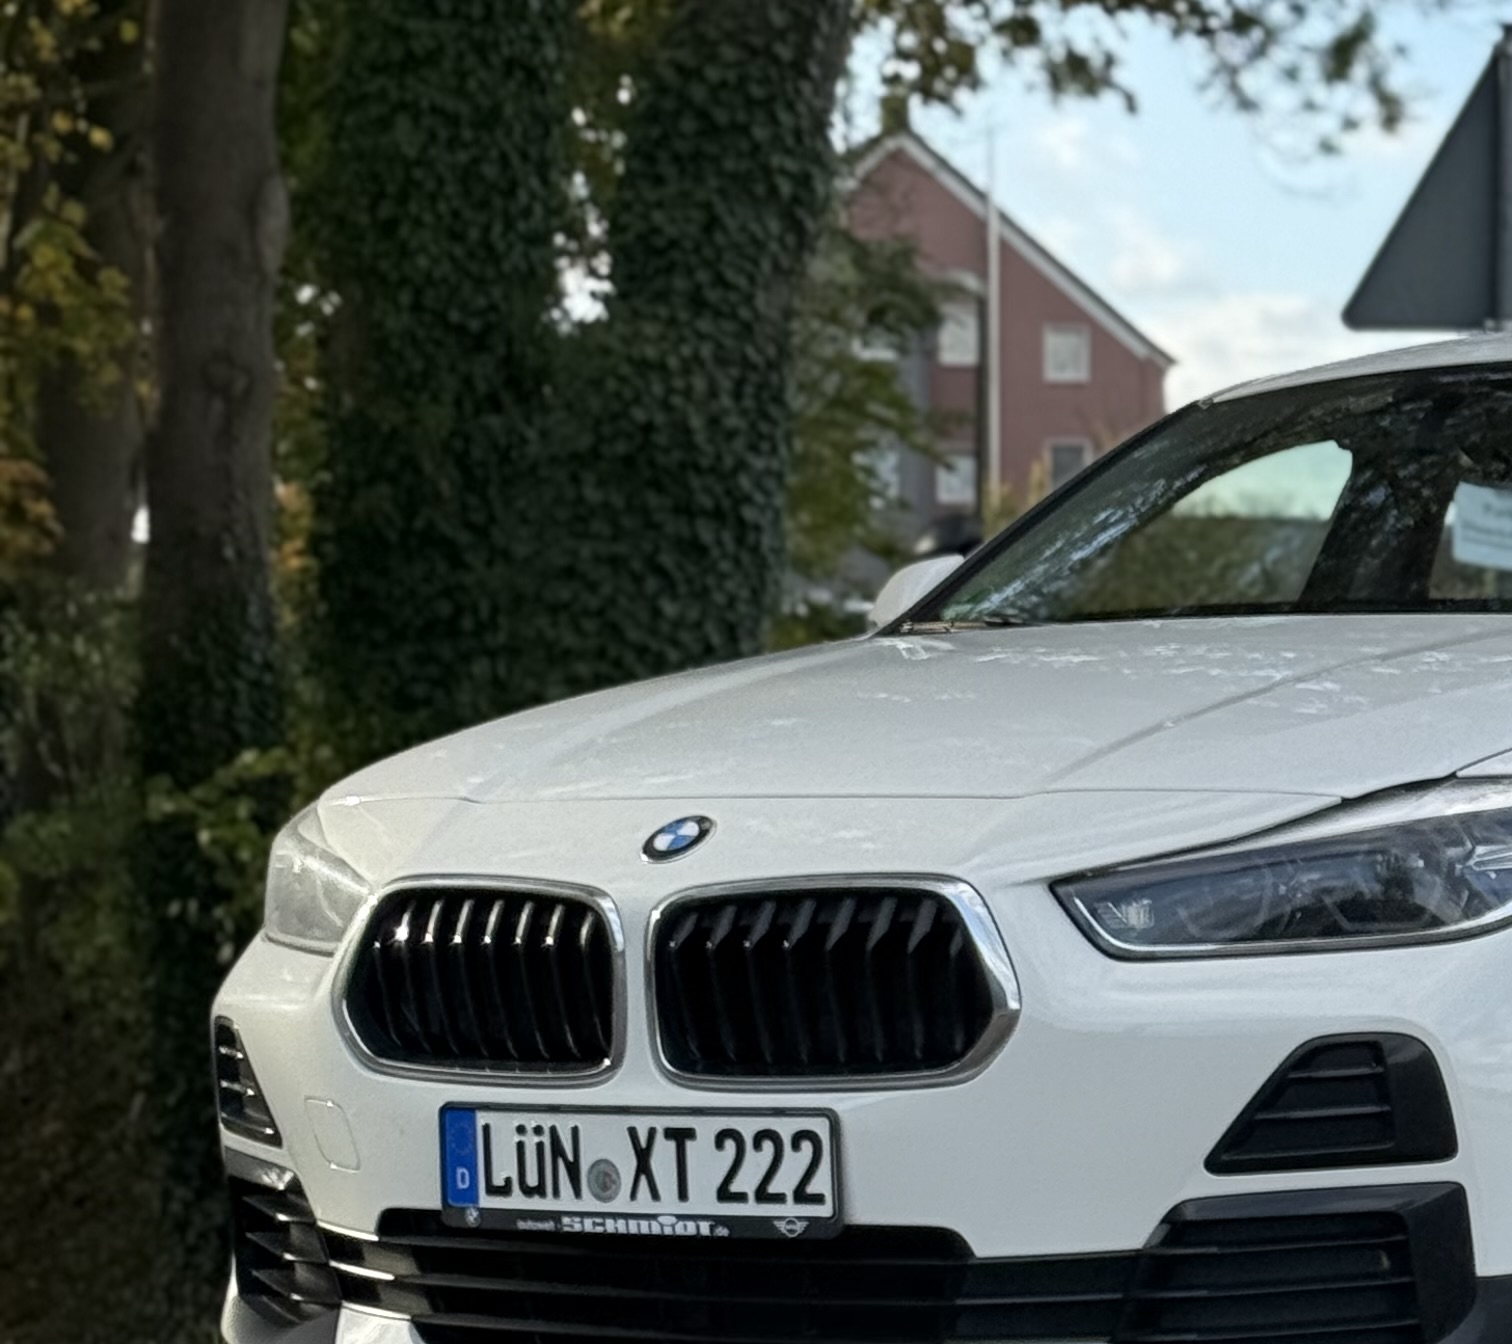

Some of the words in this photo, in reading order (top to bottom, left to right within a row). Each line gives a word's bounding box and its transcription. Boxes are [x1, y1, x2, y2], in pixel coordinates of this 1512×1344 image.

[456, 1166, 470, 1190] D
[627, 1126, 696, 1202] XT
[714, 1128, 826, 1205] 222
